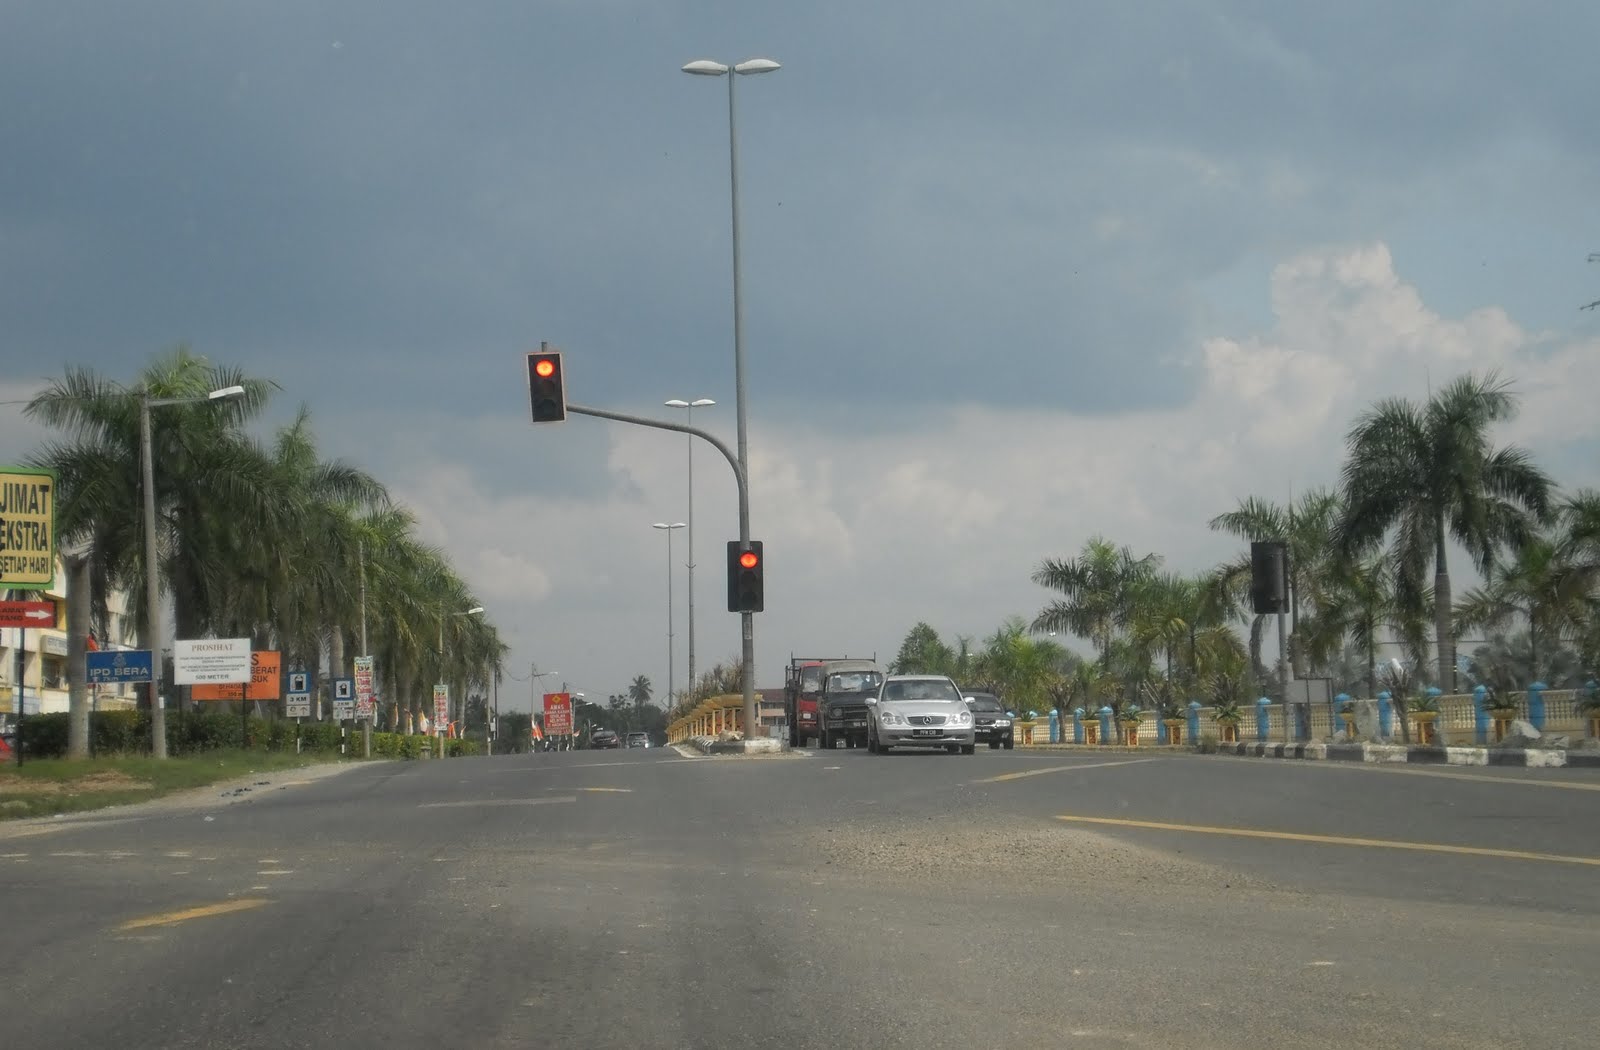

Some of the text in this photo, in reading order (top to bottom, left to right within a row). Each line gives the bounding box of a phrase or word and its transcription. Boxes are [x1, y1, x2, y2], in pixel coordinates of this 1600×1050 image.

[0, 482, 49, 515] JIMAT
[0, 520, 48, 552] EKSTRA
[0, 556, 49, 574] SETIAP HARI
[191, 643, 233, 652] PROSIHAT
[90, 667, 149, 676] IPD BERA
